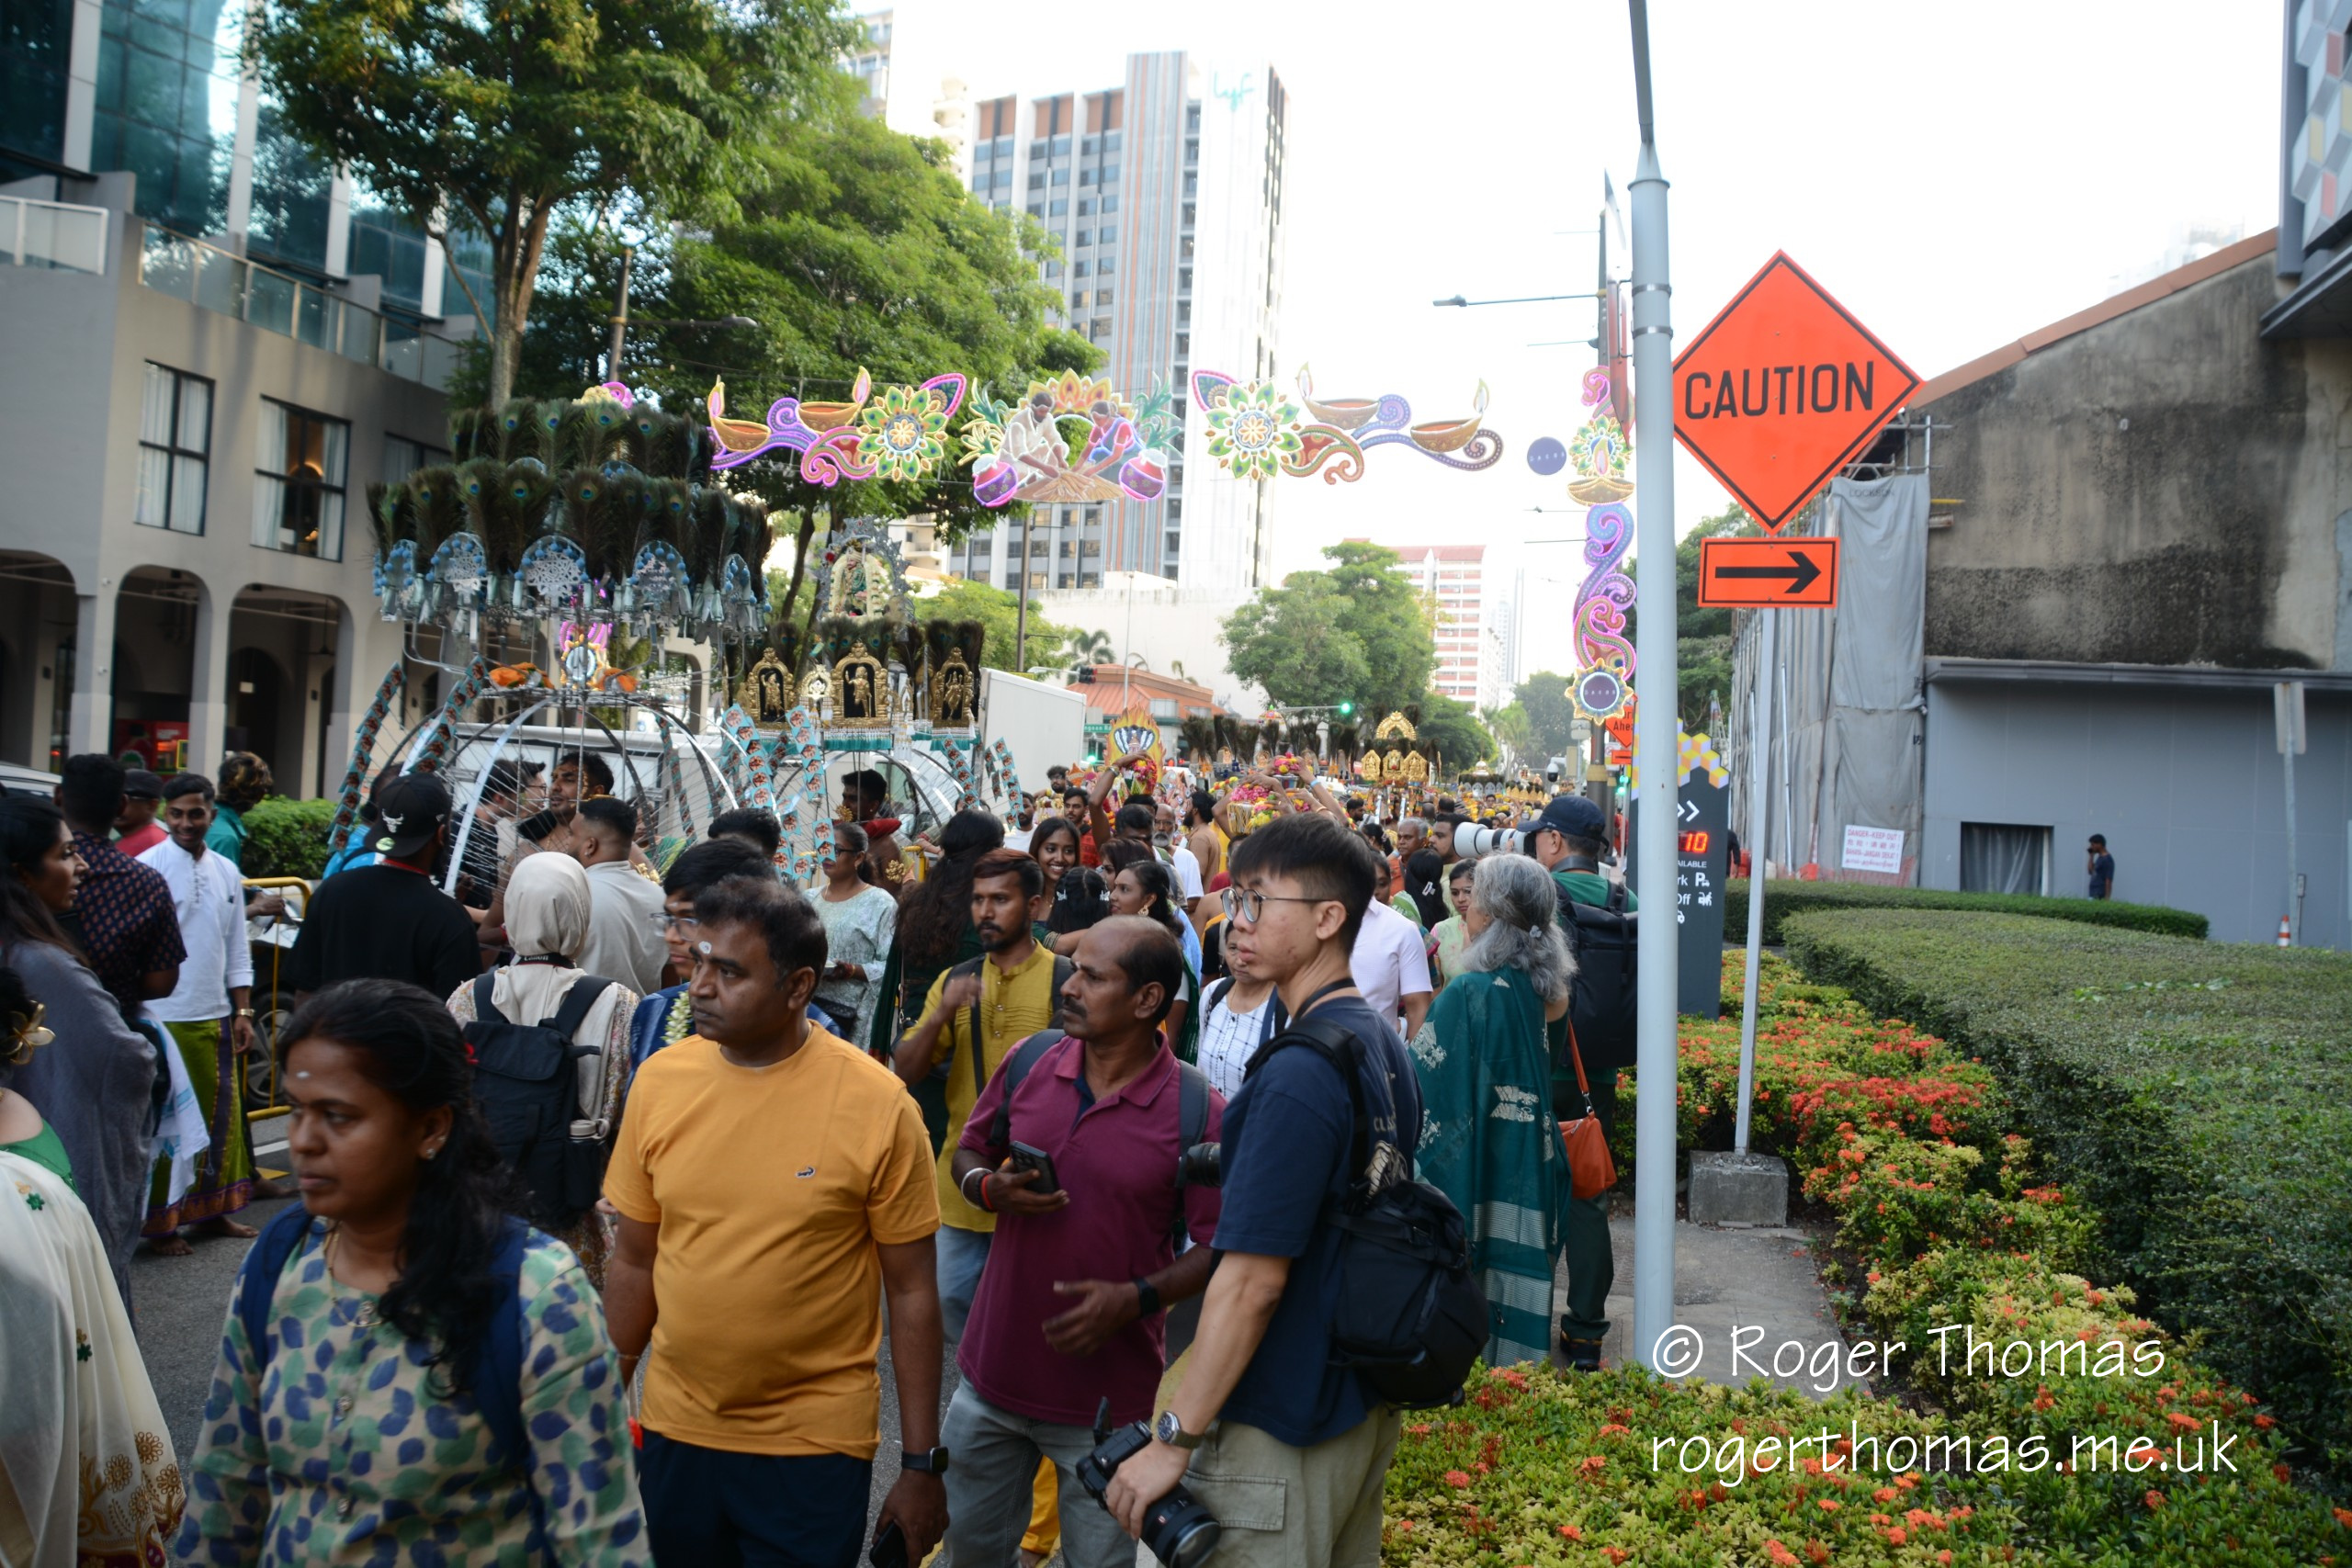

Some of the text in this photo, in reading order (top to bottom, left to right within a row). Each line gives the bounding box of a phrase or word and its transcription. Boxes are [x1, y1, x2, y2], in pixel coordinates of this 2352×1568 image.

[1684, 361, 1874, 420] CAUTION
[1685, 831, 1708, 852] 10
[1678, 860, 1707, 868] AILABLE
[1678, 874, 1689, 886] rk
